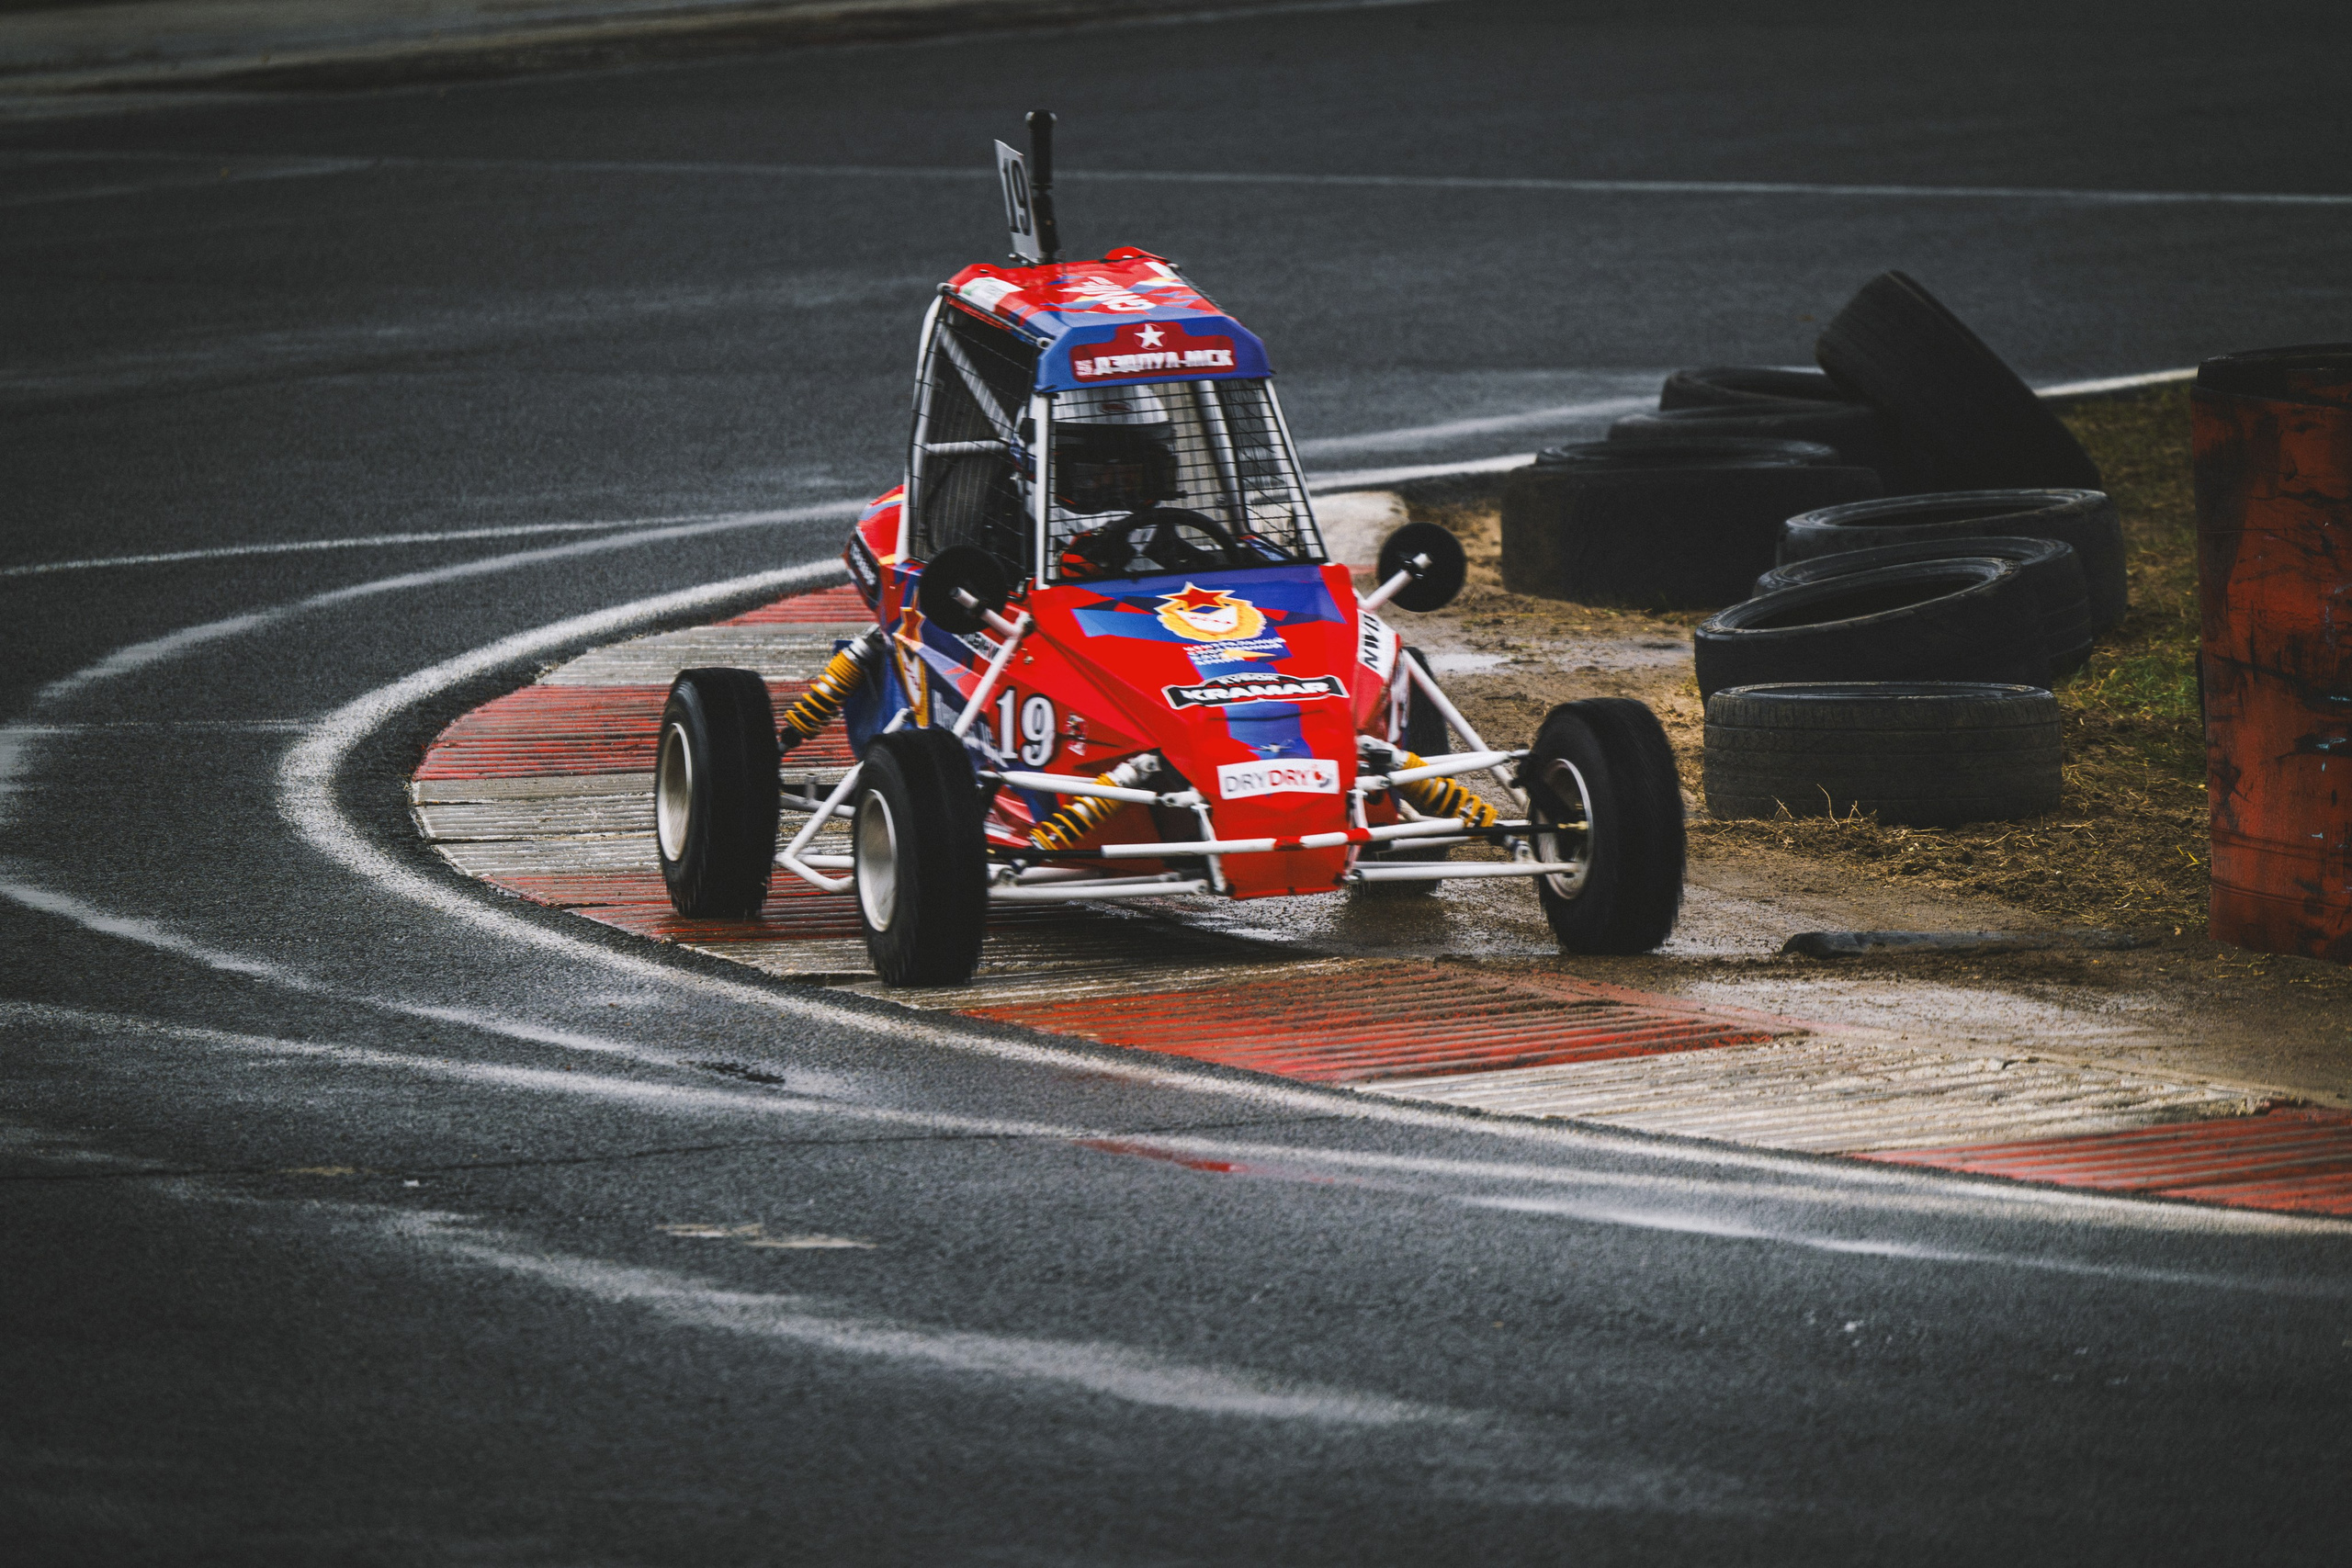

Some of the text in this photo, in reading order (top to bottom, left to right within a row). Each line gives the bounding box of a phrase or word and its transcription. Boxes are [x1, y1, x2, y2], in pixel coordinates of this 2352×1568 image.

[1002, 157, 1032, 237] 19
[1179, 682, 1332, 701] KRAMAR
[996, 686, 1056, 767] 19
[1225, 769, 1310, 793] DRYDRY
